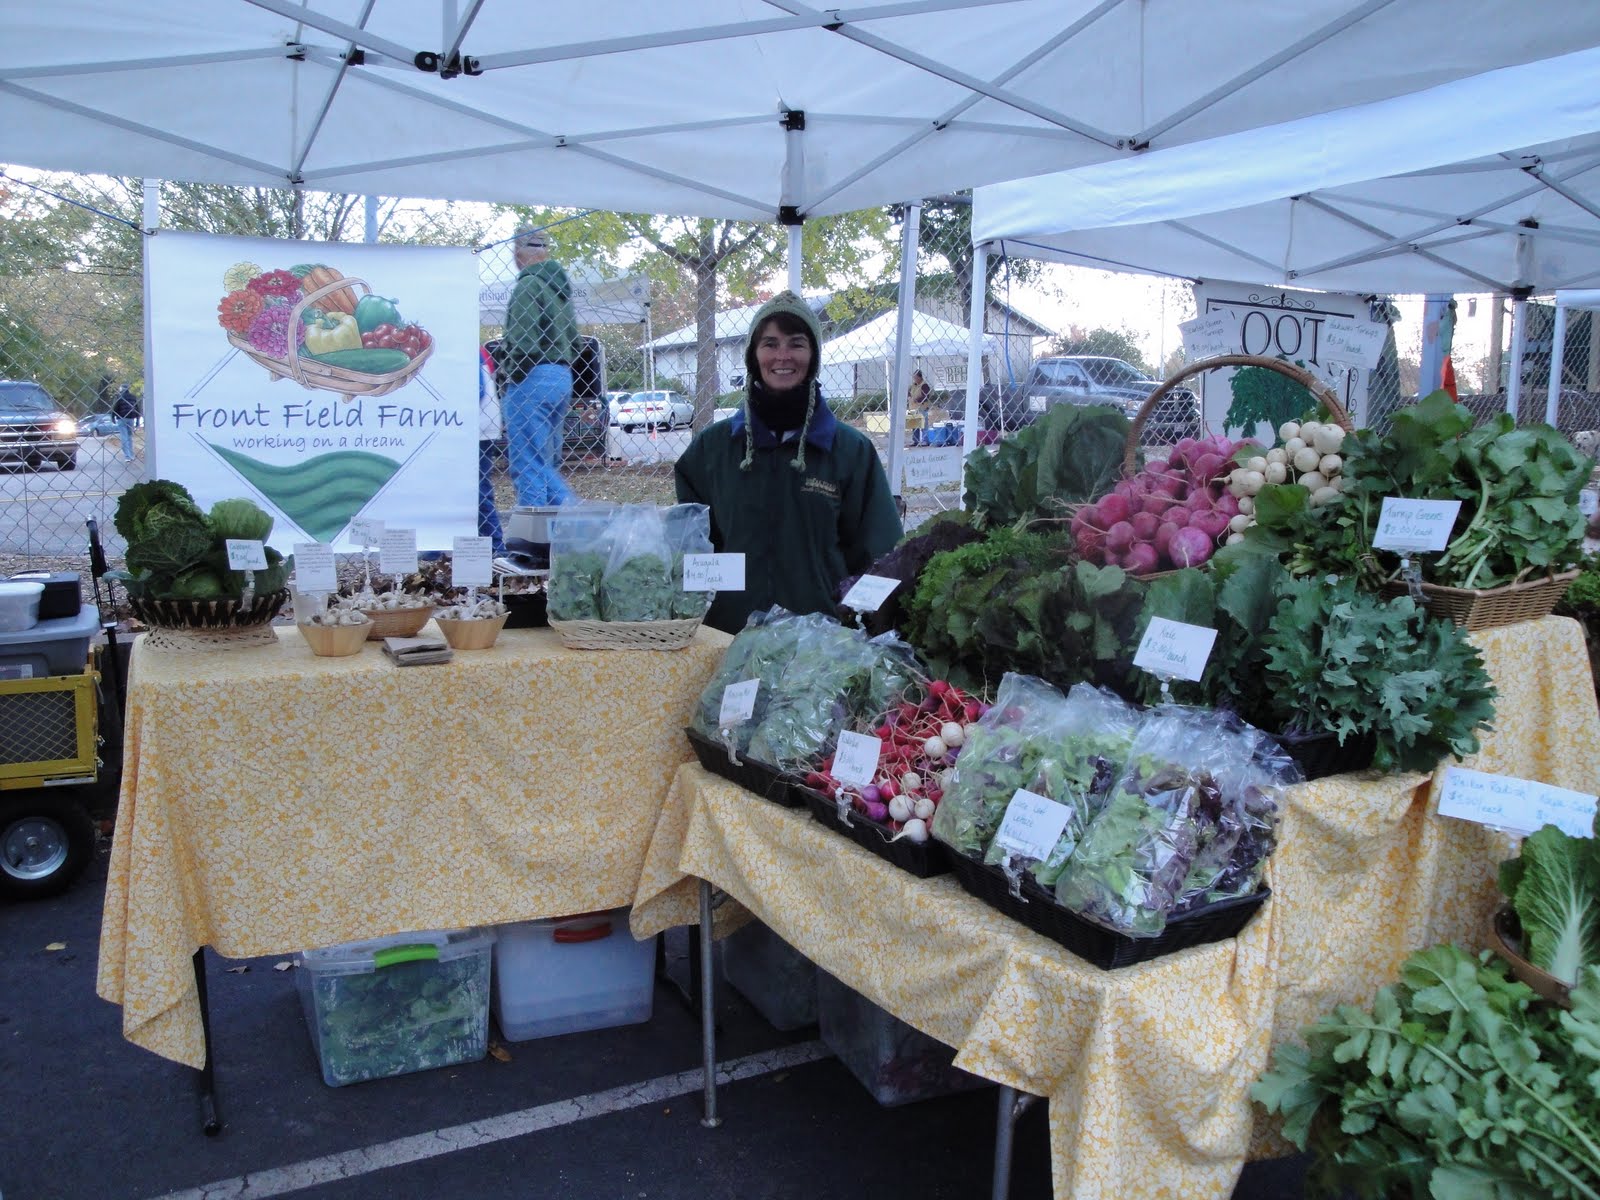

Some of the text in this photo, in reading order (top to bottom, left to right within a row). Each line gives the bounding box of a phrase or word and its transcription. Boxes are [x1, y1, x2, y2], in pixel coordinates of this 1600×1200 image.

[172, 400, 464, 429] Front Field Farm
[232, 434, 405, 452] working on a dream
[1384, 504, 1413, 524] Turnip
[692, 557, 721, 567] Arugula
[1160, 624, 1177, 640] Kale
